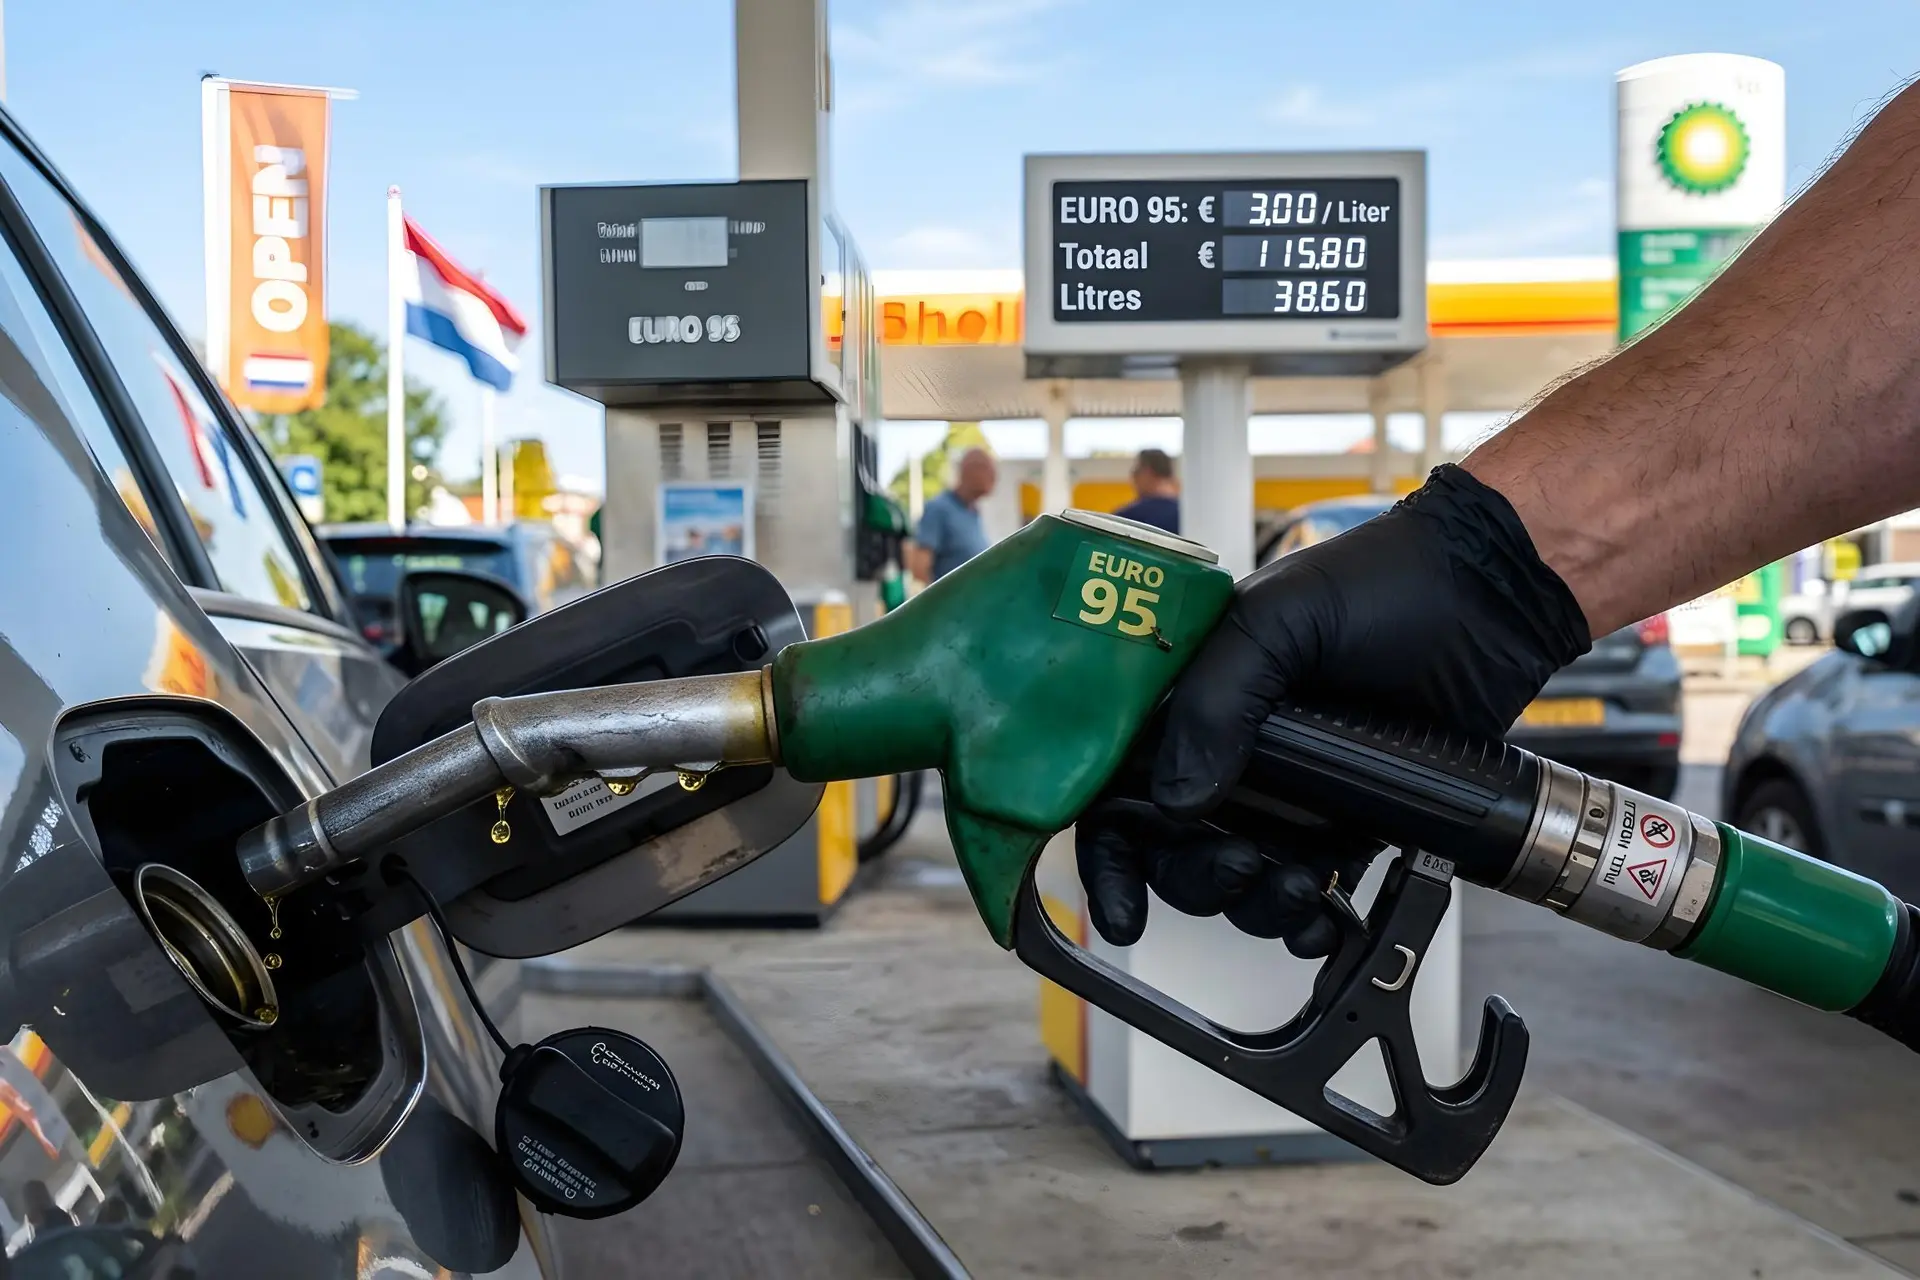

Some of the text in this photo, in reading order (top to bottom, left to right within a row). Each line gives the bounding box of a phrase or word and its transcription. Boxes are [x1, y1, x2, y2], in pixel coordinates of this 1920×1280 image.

[1060, 196, 1139, 224] EURO
[1147, 196, 1188, 224] 95:
[1198, 196, 1215, 223] €
[1249, 193, 1317, 226] 3,00
[1338, 200, 1390, 223] Liter
[251, 144, 308, 333] OPEN
[1059, 241, 1148, 270] Totaal
[1198, 241, 1215, 268] €
[1060, 280, 1366, 313] Litres 38,60
[706, 315, 741, 342] 95
[1089, 551, 1164, 588] EURO
[1078, 578, 1160, 636] 95
